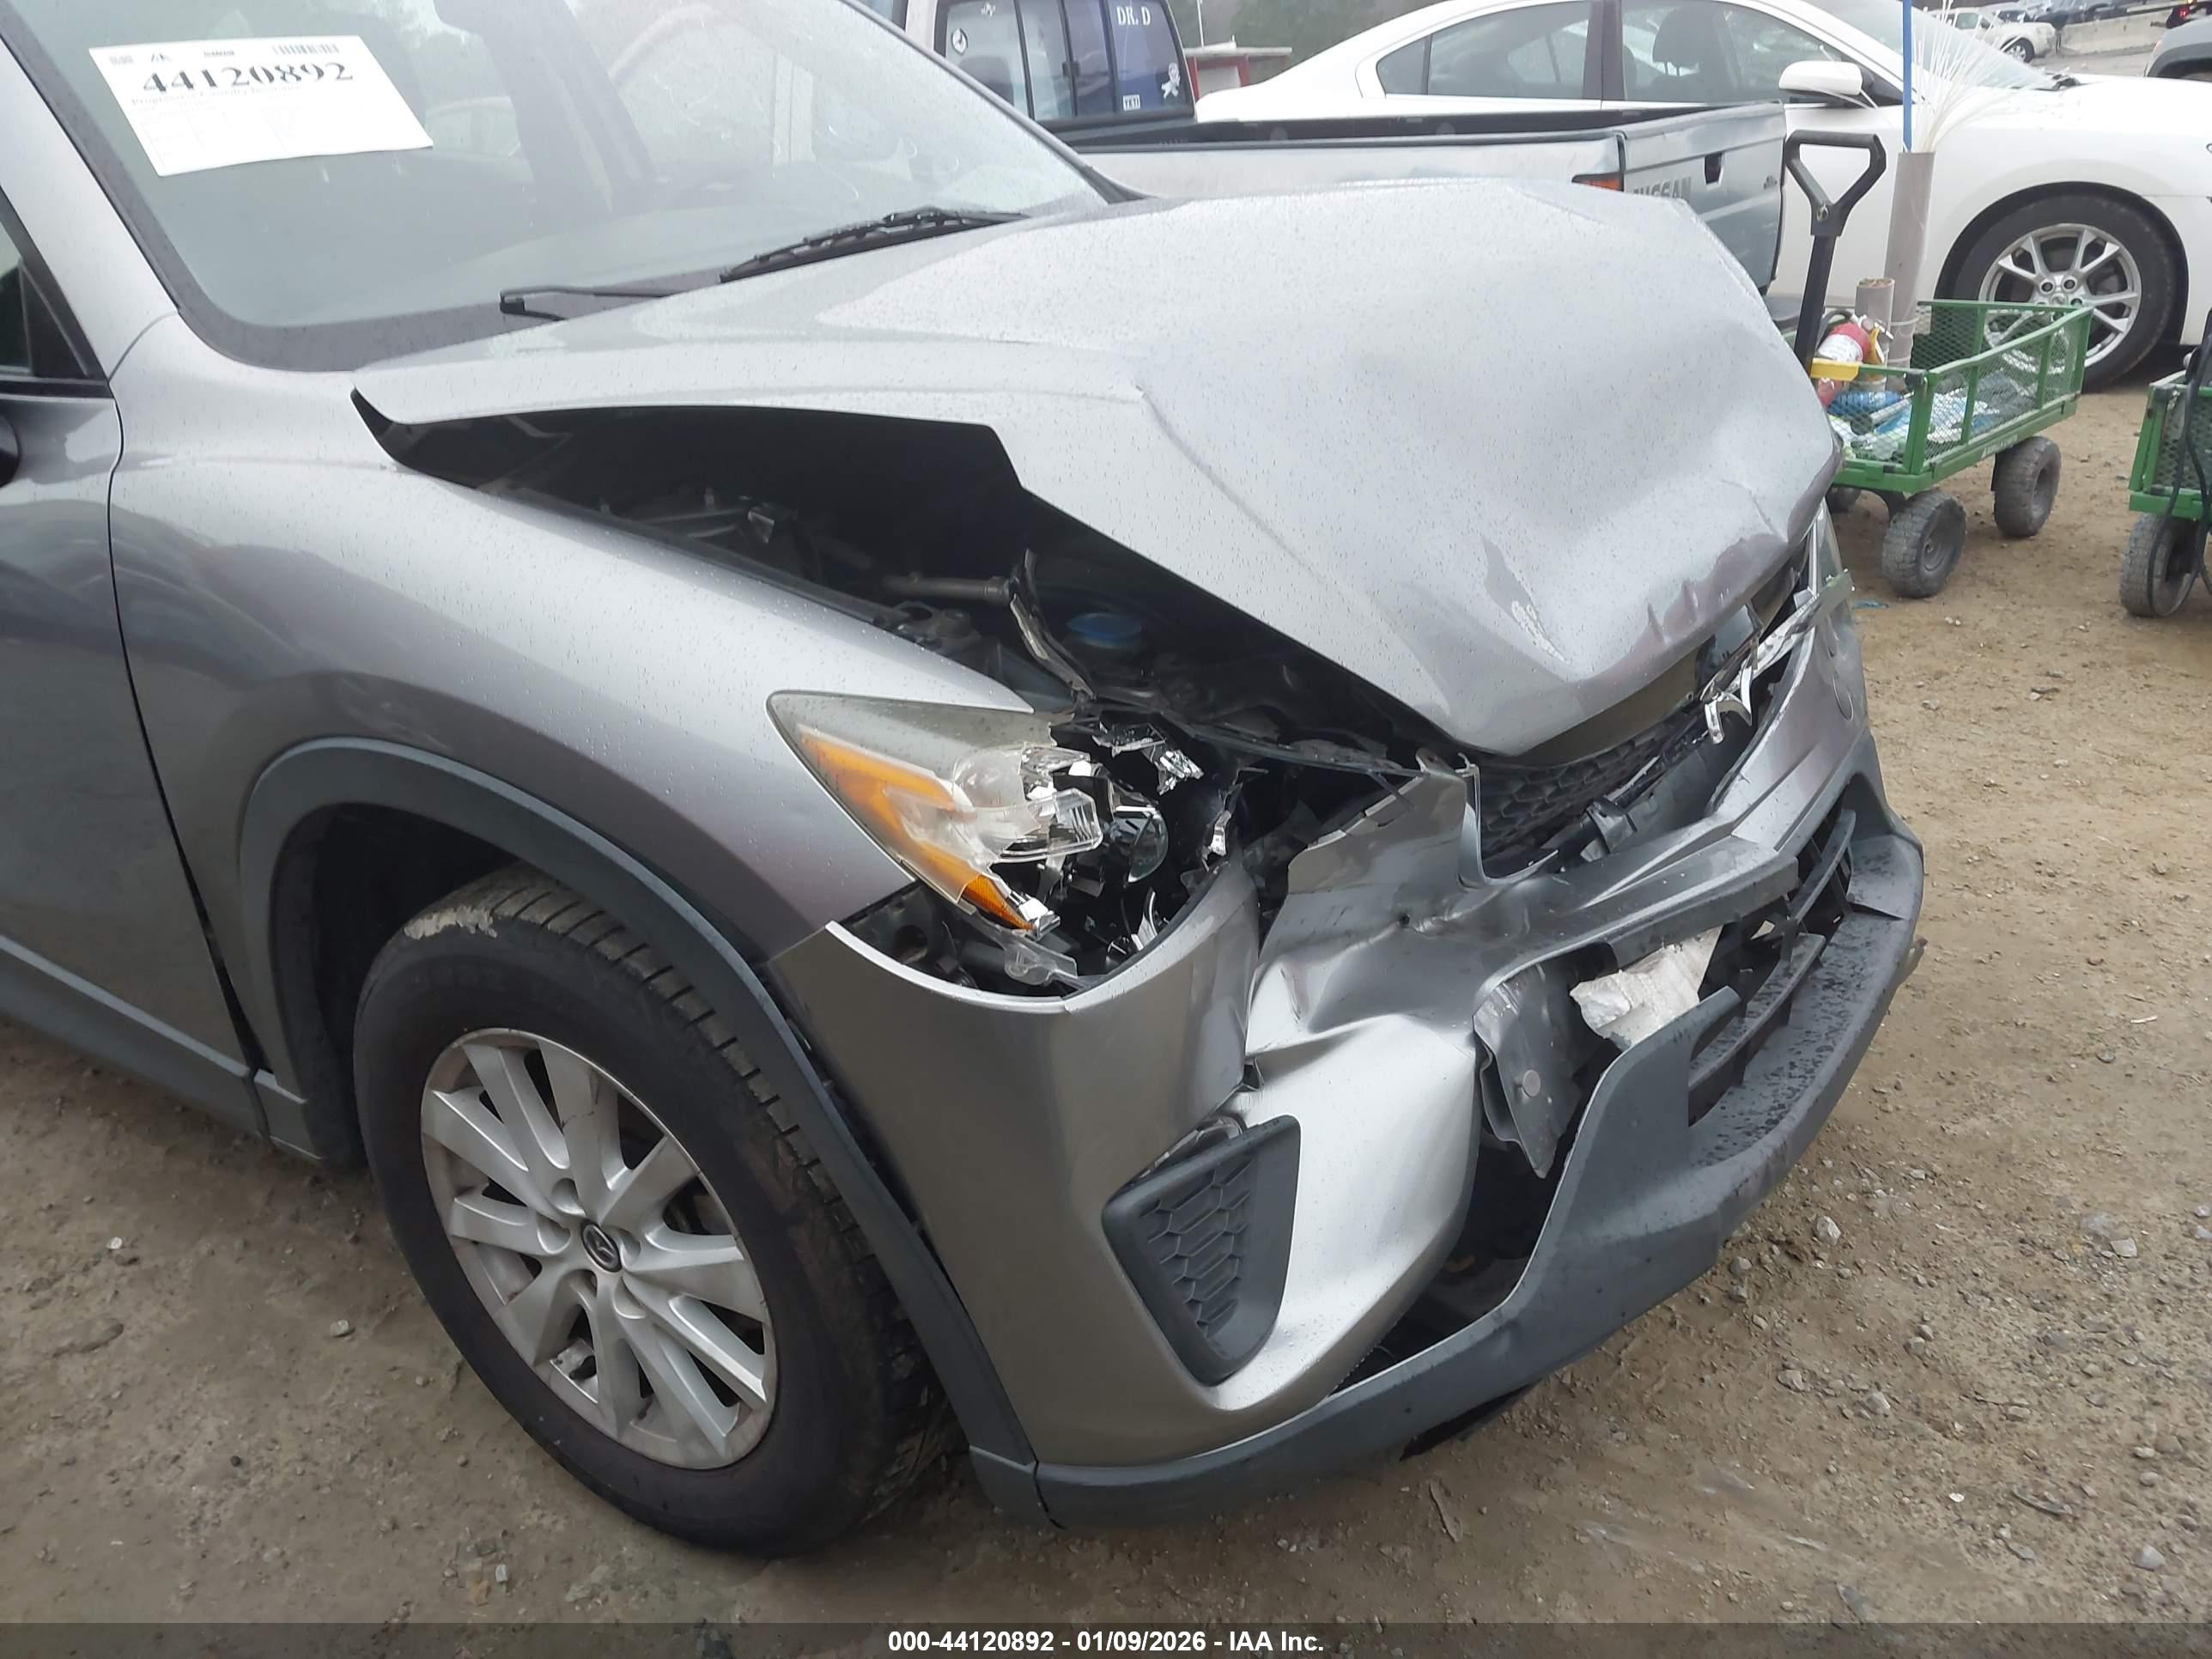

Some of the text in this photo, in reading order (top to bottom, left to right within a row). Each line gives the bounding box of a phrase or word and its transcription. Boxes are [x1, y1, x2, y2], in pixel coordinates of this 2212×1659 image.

[1116, 6, 1152, 26] DR. D
[143, 61, 353, 94] 44120892
[1633, 177, 1691, 204] SSAN
